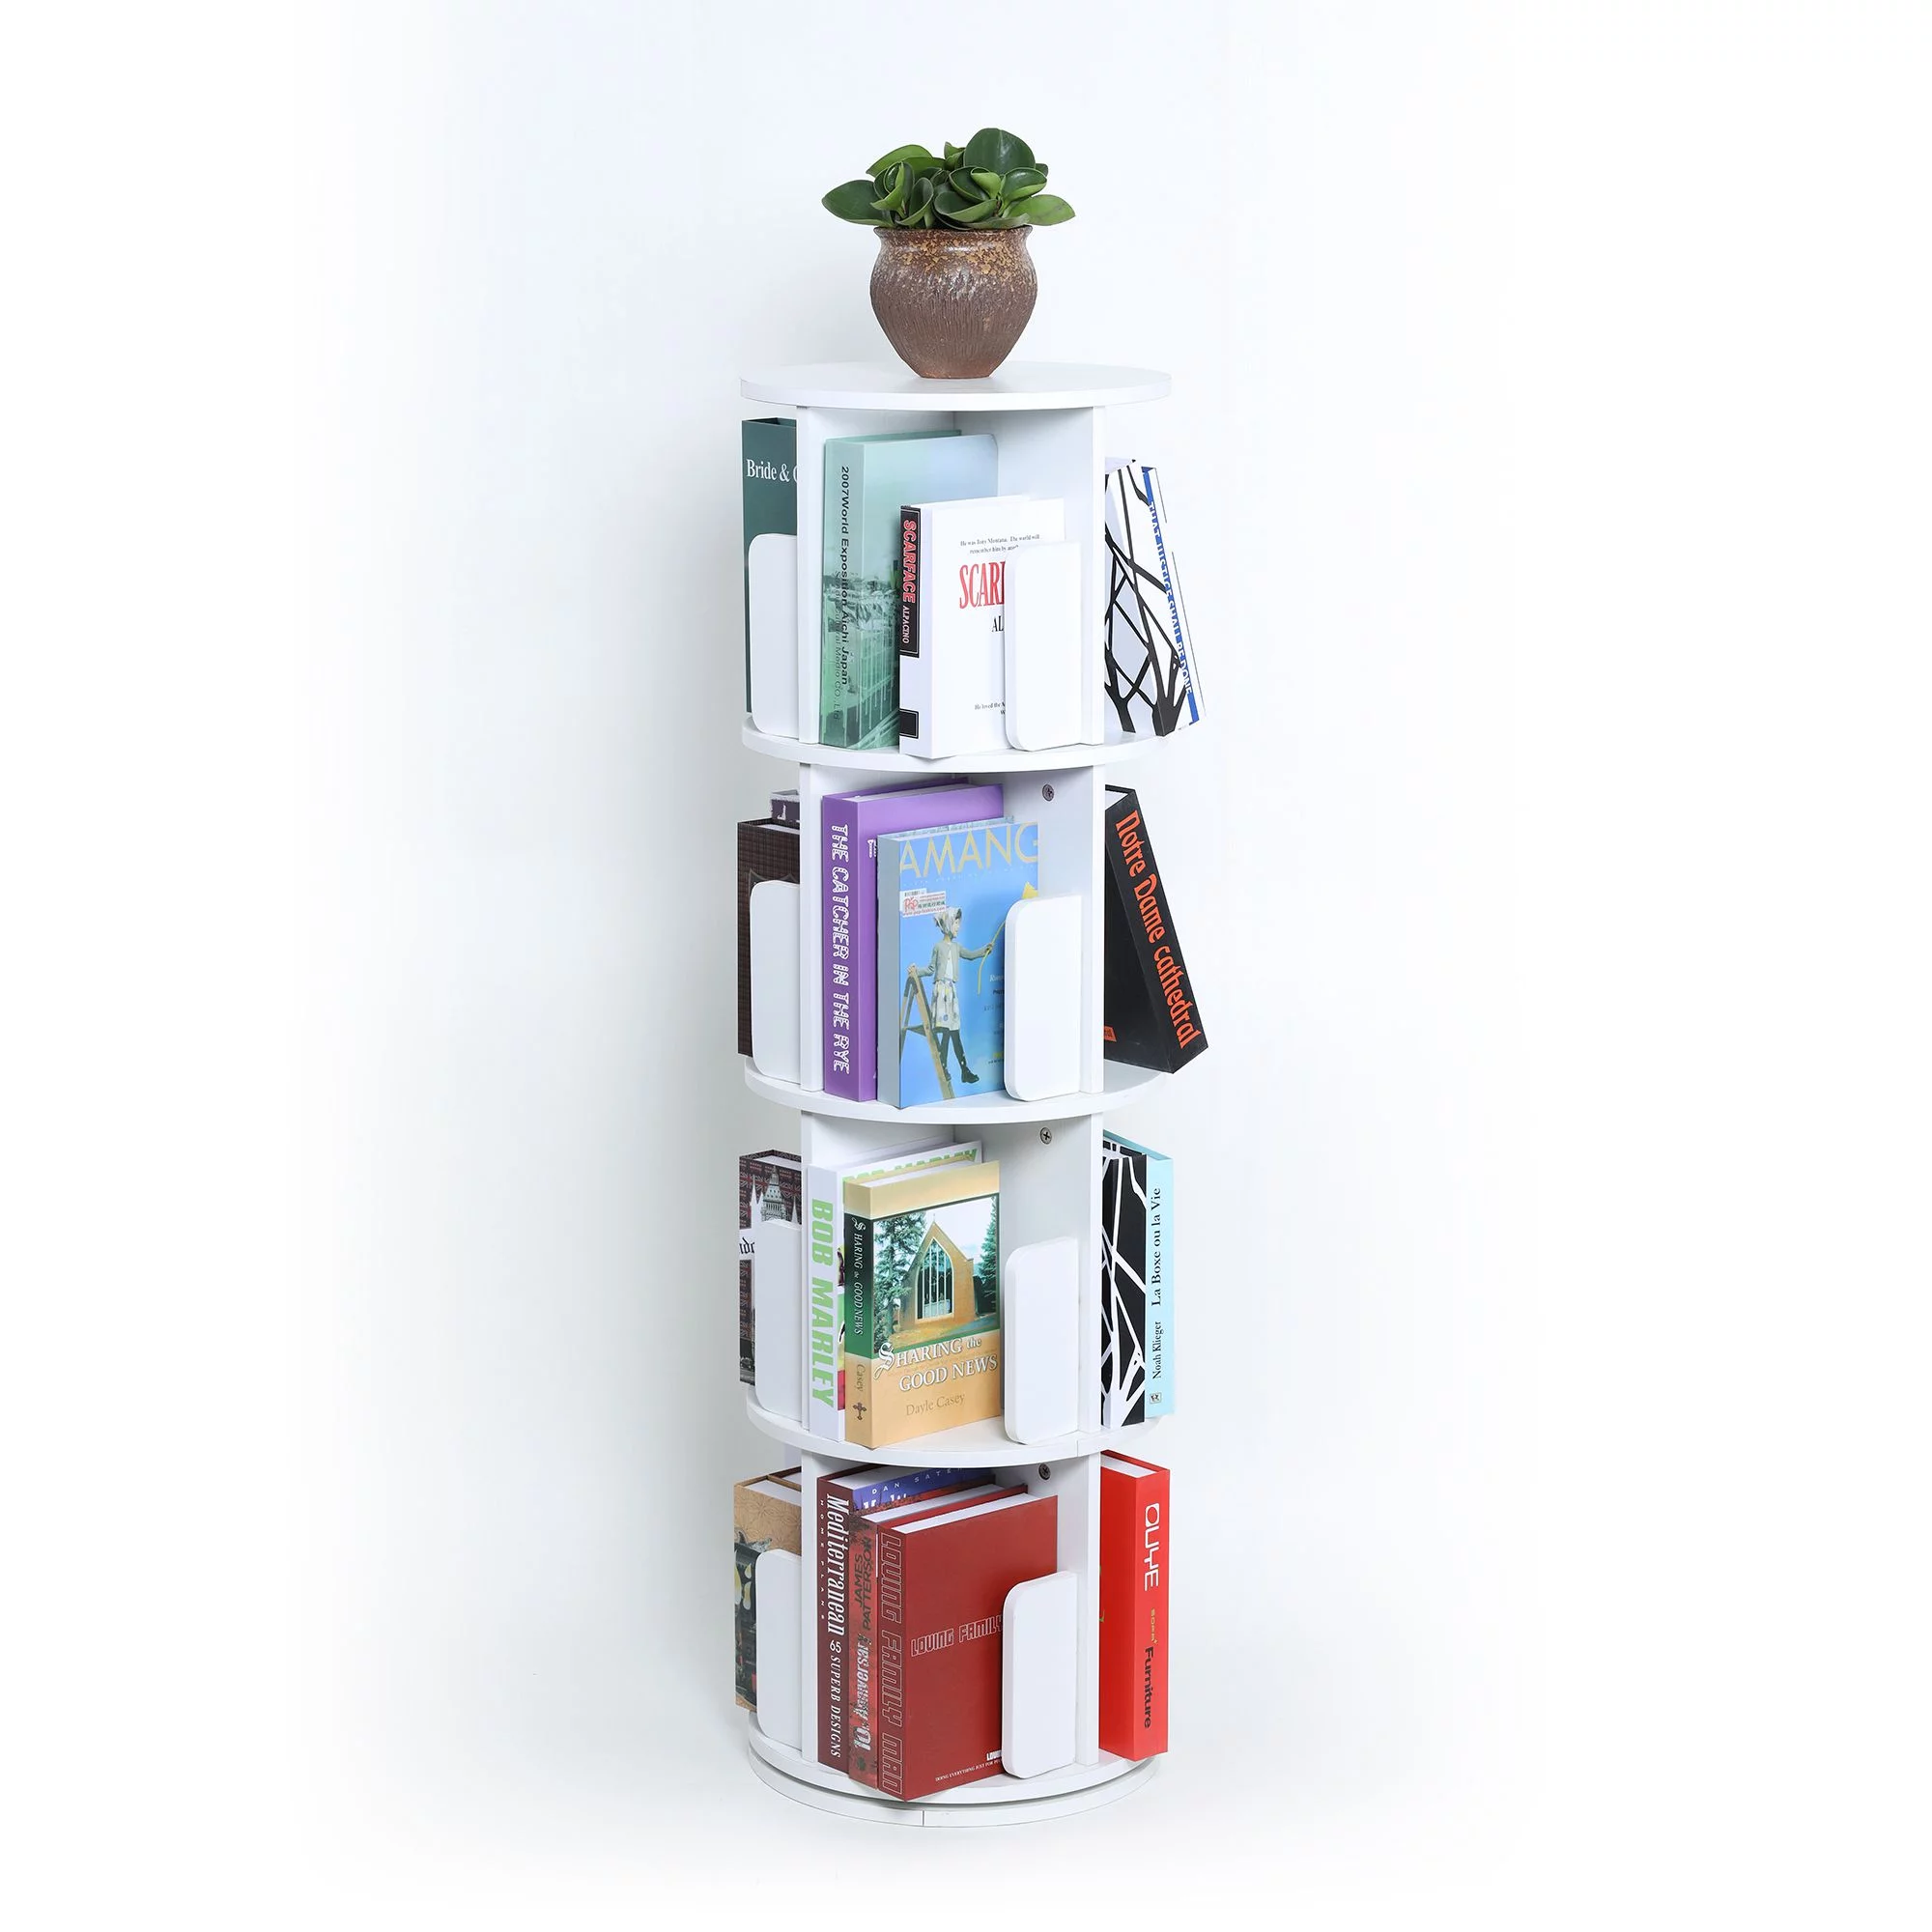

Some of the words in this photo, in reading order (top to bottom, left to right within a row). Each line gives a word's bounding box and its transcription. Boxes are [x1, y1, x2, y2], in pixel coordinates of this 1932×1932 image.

[746, 459, 777, 480] Bride
[779, 463, 790, 482] &
[841, 467, 850, 533] 2007World
[840, 538, 849, 606] Exposition
[902, 520, 917, 604] SCARFACE
[840, 647, 849, 685] Japan
[832, 824, 849, 862] THE
[832, 867, 849, 959] CATCHER
[1116, 810, 1147, 878] Notre
[1134, 873, 1166, 944] Dame
[1153, 945, 1202, 1049] cathedral
[833, 964, 849, 985] IN
[833, 992, 850, 1030] THE
[833, 1033, 850, 1074] RYE
[1151, 1187, 1161, 1210] Vie
[811, 1199, 834, 1266] BOB
[1151, 1213, 1161, 1226] la
[1153, 1230, 1161, 1247] ou
[852, 1217, 866, 1268] SHARING
[1151, 1251, 1161, 1284] Boxe
[853, 1282, 864, 1307] GOOD
[1151, 1289, 1161, 1306] La
[854, 1308, 864, 1335] NEWS
[811, 1276, 834, 1408] MARLEY
[873, 1337, 963, 1380] SHARING
[966, 1336, 981, 1350] the
[856, 1363, 866, 1392] Casey
[899, 1367, 947, 1392] GOOD
[952, 1353, 998, 1379] NEWS
[1151, 1353, 1162, 1379] Noah
[906, 1399, 933, 1416] Dayle
[936, 1393, 965, 1408] Casey
[871, 1482, 899, 1494] DAN
[827, 1493, 849, 1636] Mediterranean
[854, 1552, 864, 1607] JAMES
[863, 1537, 873, 1631] PATTERSON
[880, 1532, 901, 1624] LOVING
[830, 1640, 842, 1654] 65
[910, 1628, 954, 1658] LOVING
[830, 1655, 841, 1702] SUPERB
[881, 1629, 902, 1727] FAMILY
[1144, 1646, 1154, 1729] Furniture
[830, 1705, 841, 1758] DESIGNS
[882, 1732, 903, 1795] MAN
